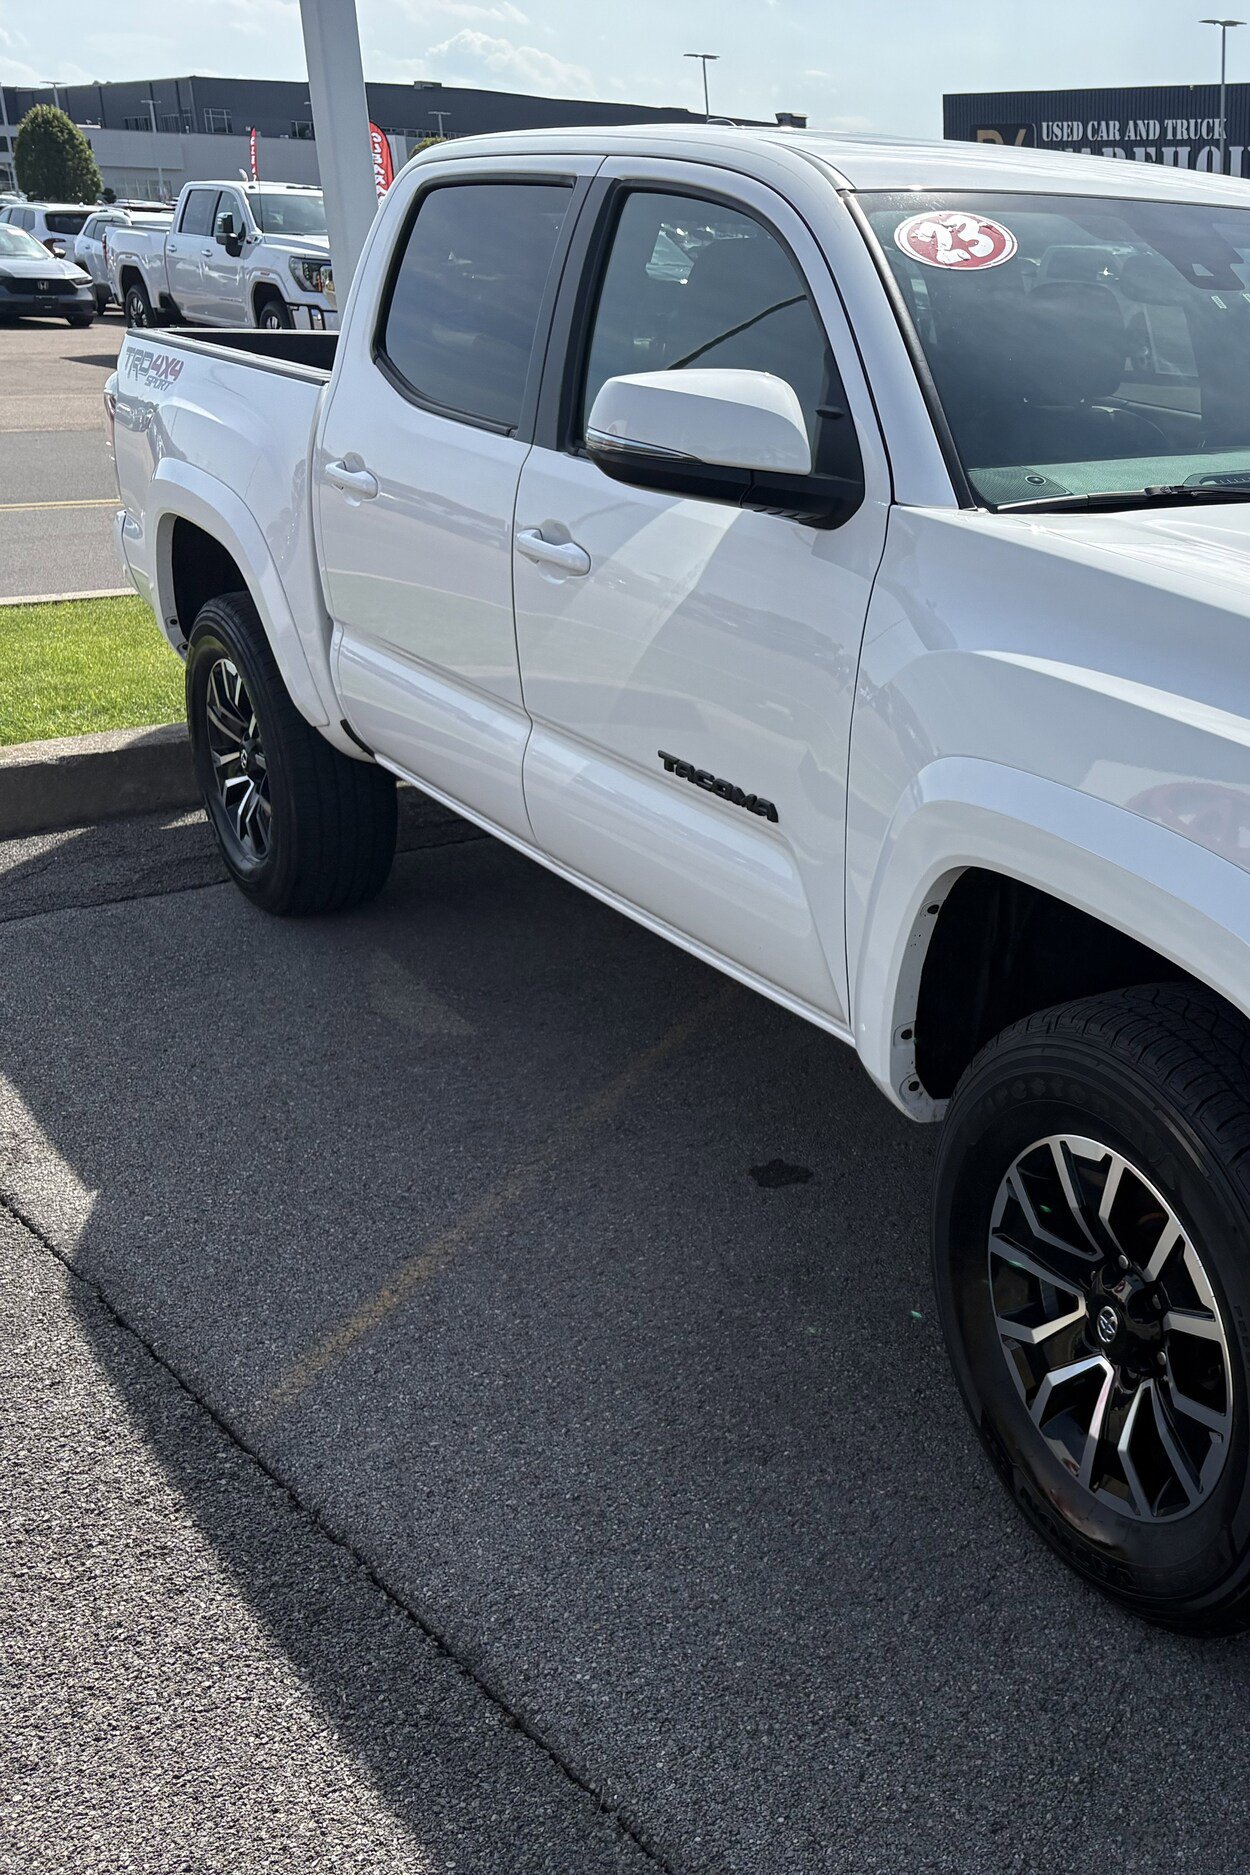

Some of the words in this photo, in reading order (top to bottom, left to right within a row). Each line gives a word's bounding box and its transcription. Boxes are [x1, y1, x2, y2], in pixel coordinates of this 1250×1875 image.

[1042, 121, 1084, 141] USED
[1087, 120, 1121, 141] CAR
[1124, 120, 1161, 140] AND
[1164, 118, 1228, 140] TRUCK
[911, 214, 995, 265] 23
[125, 346, 155, 382] TRD
[144, 375, 174, 391] SPORT
[657, 749, 779, 823] TACOMA
